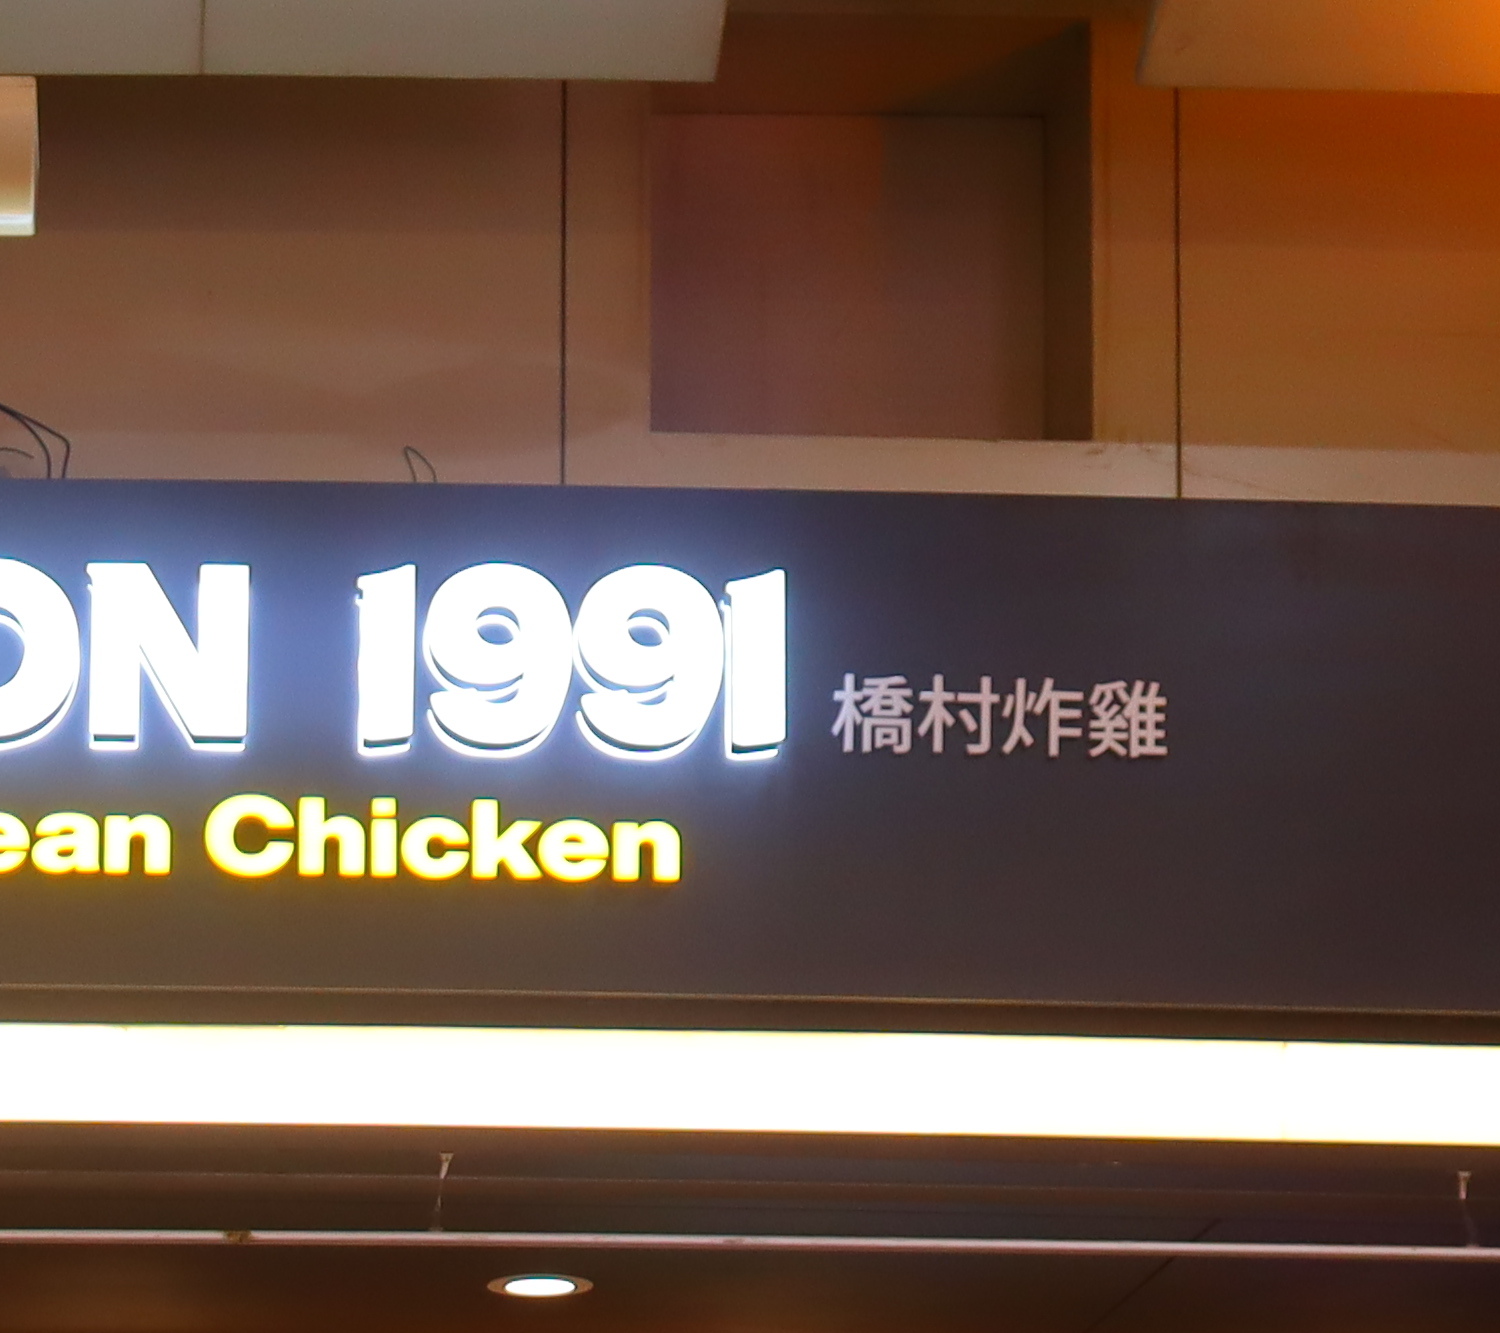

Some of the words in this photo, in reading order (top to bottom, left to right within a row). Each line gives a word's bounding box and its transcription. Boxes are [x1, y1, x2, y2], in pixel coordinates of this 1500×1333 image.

[352, 562, 790, 762] 1991
[831, 670, 1170, 763] 橋村炸雞
[203, 795, 684, 886] Chicken
